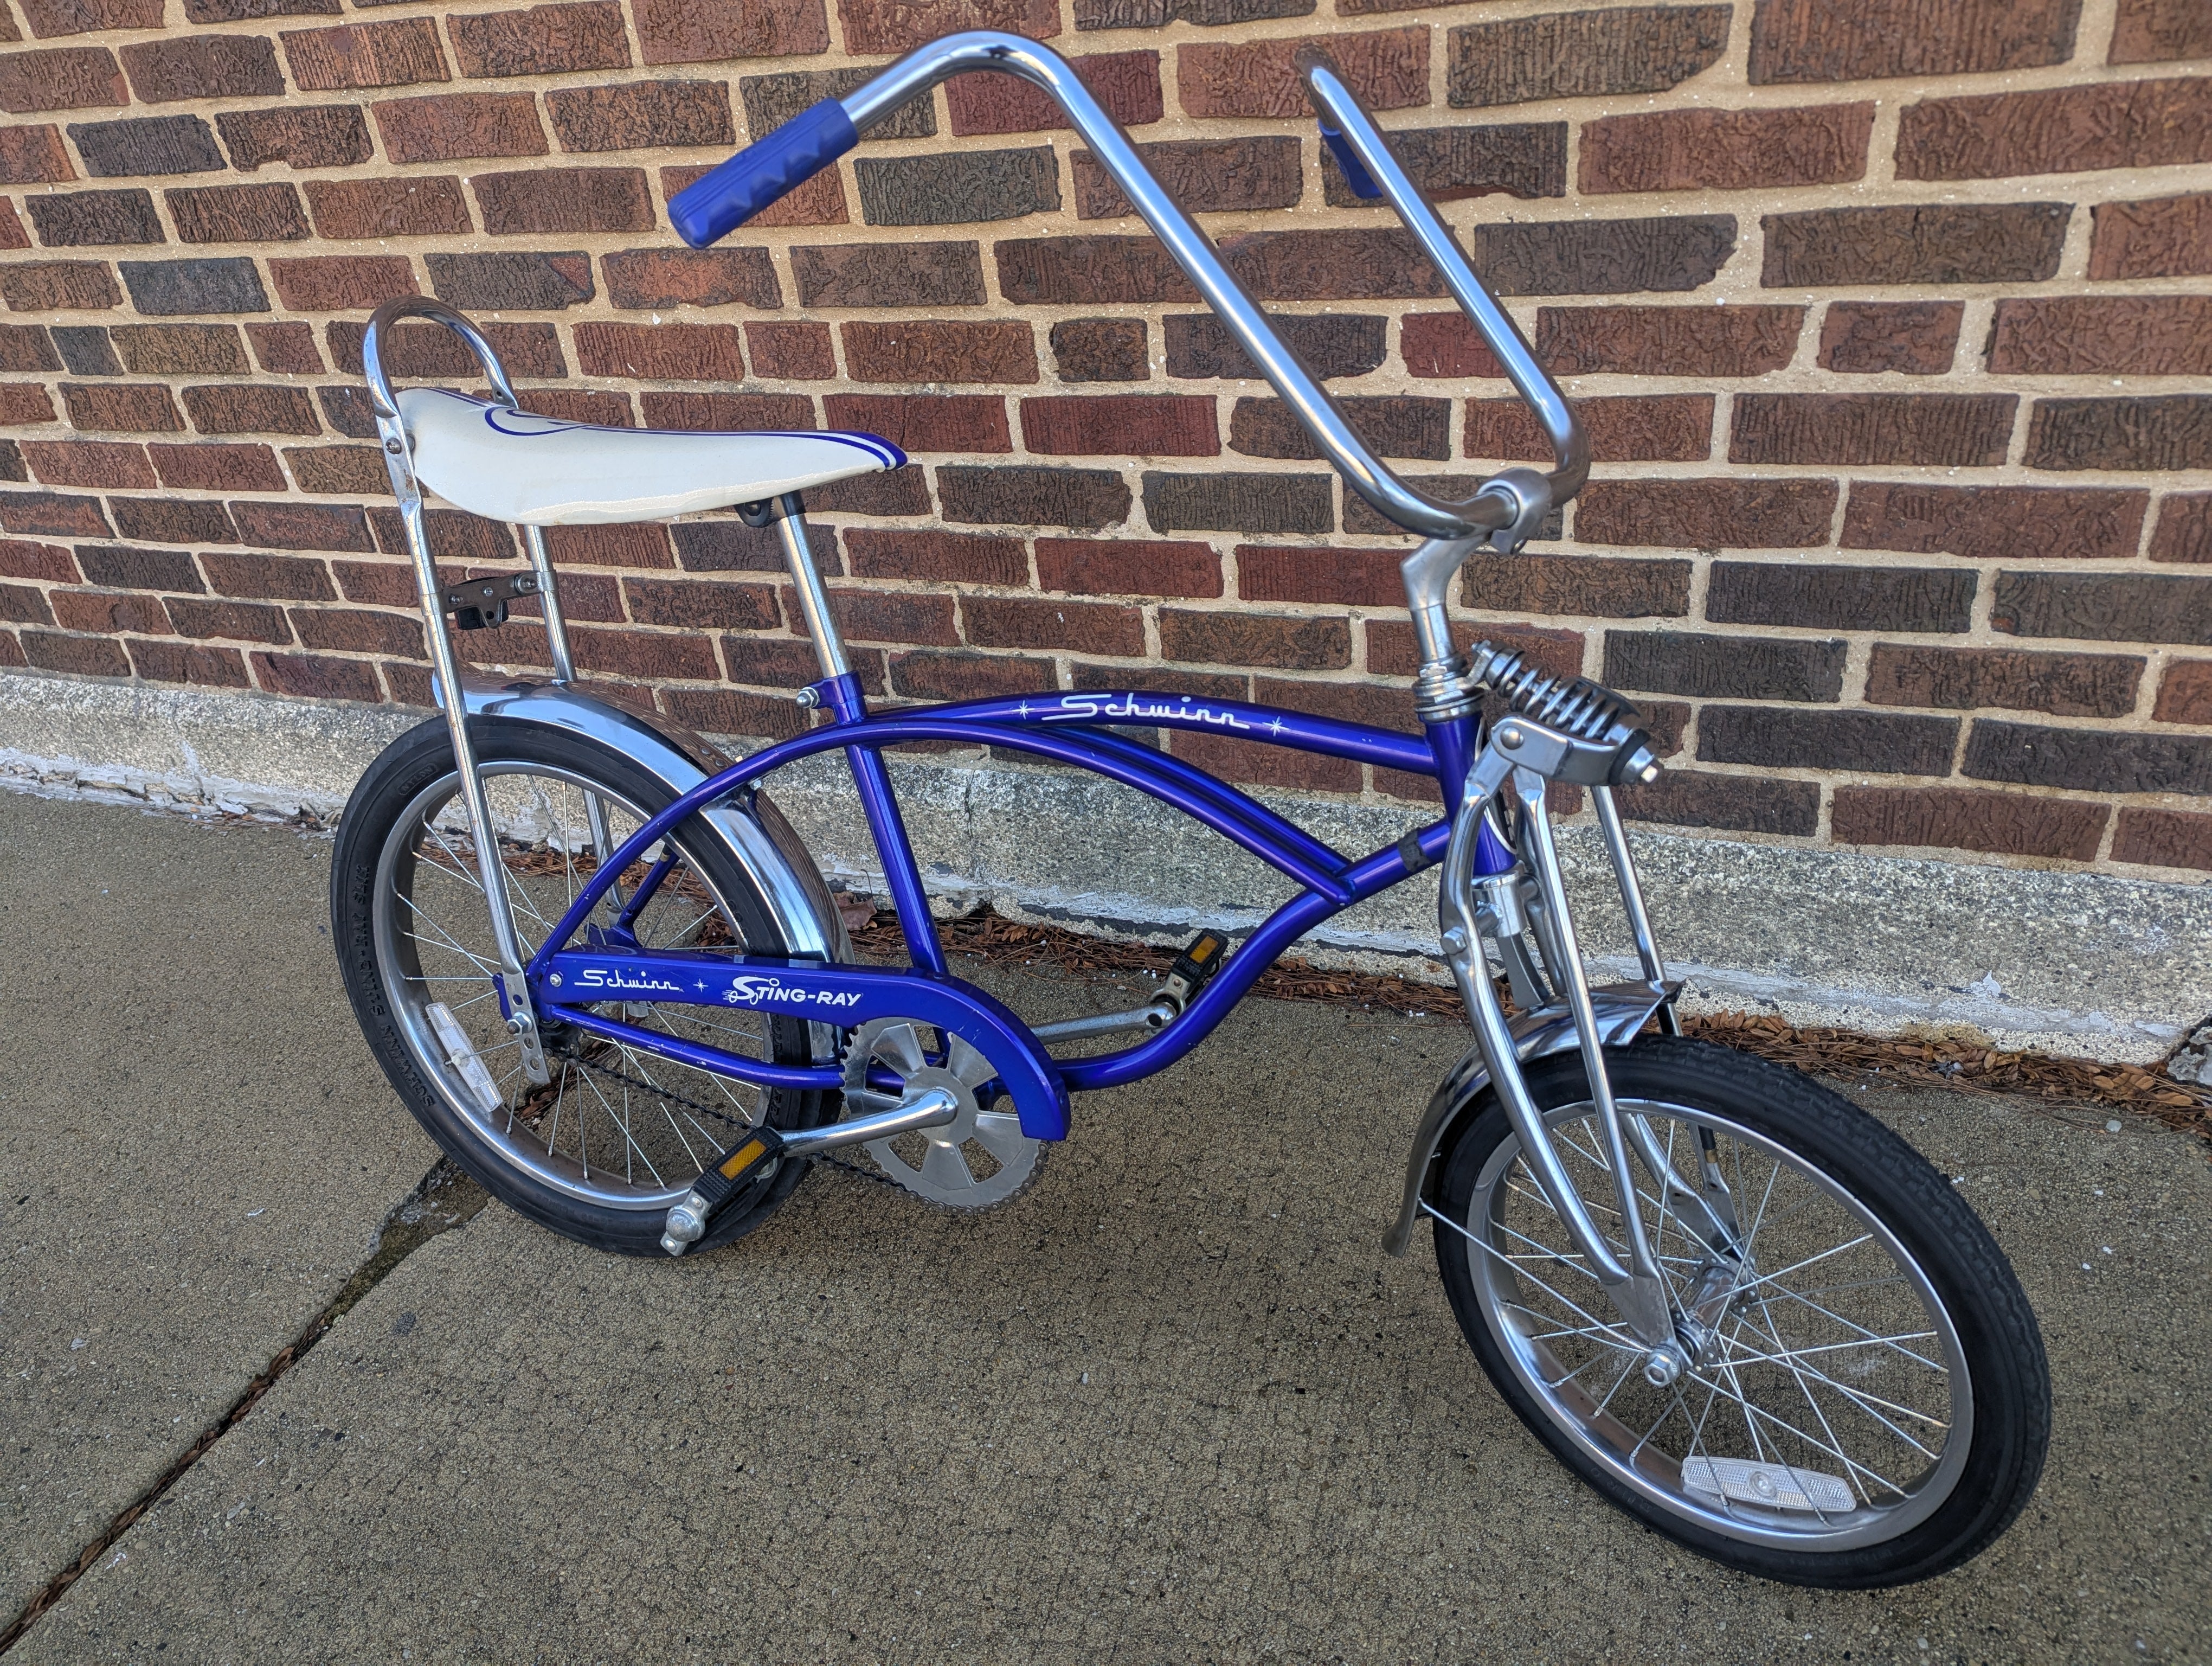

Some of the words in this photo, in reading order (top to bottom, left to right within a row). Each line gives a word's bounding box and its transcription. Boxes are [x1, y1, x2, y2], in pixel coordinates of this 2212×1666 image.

[1041, 692, 1250, 730] Schwinn
[352, 912, 385, 1017] STING-RAY
[574, 969, 680, 990] Schwinn
[722, 976, 862, 1006] STING-RAY
[379, 1023, 436, 1106] SCHWINN
